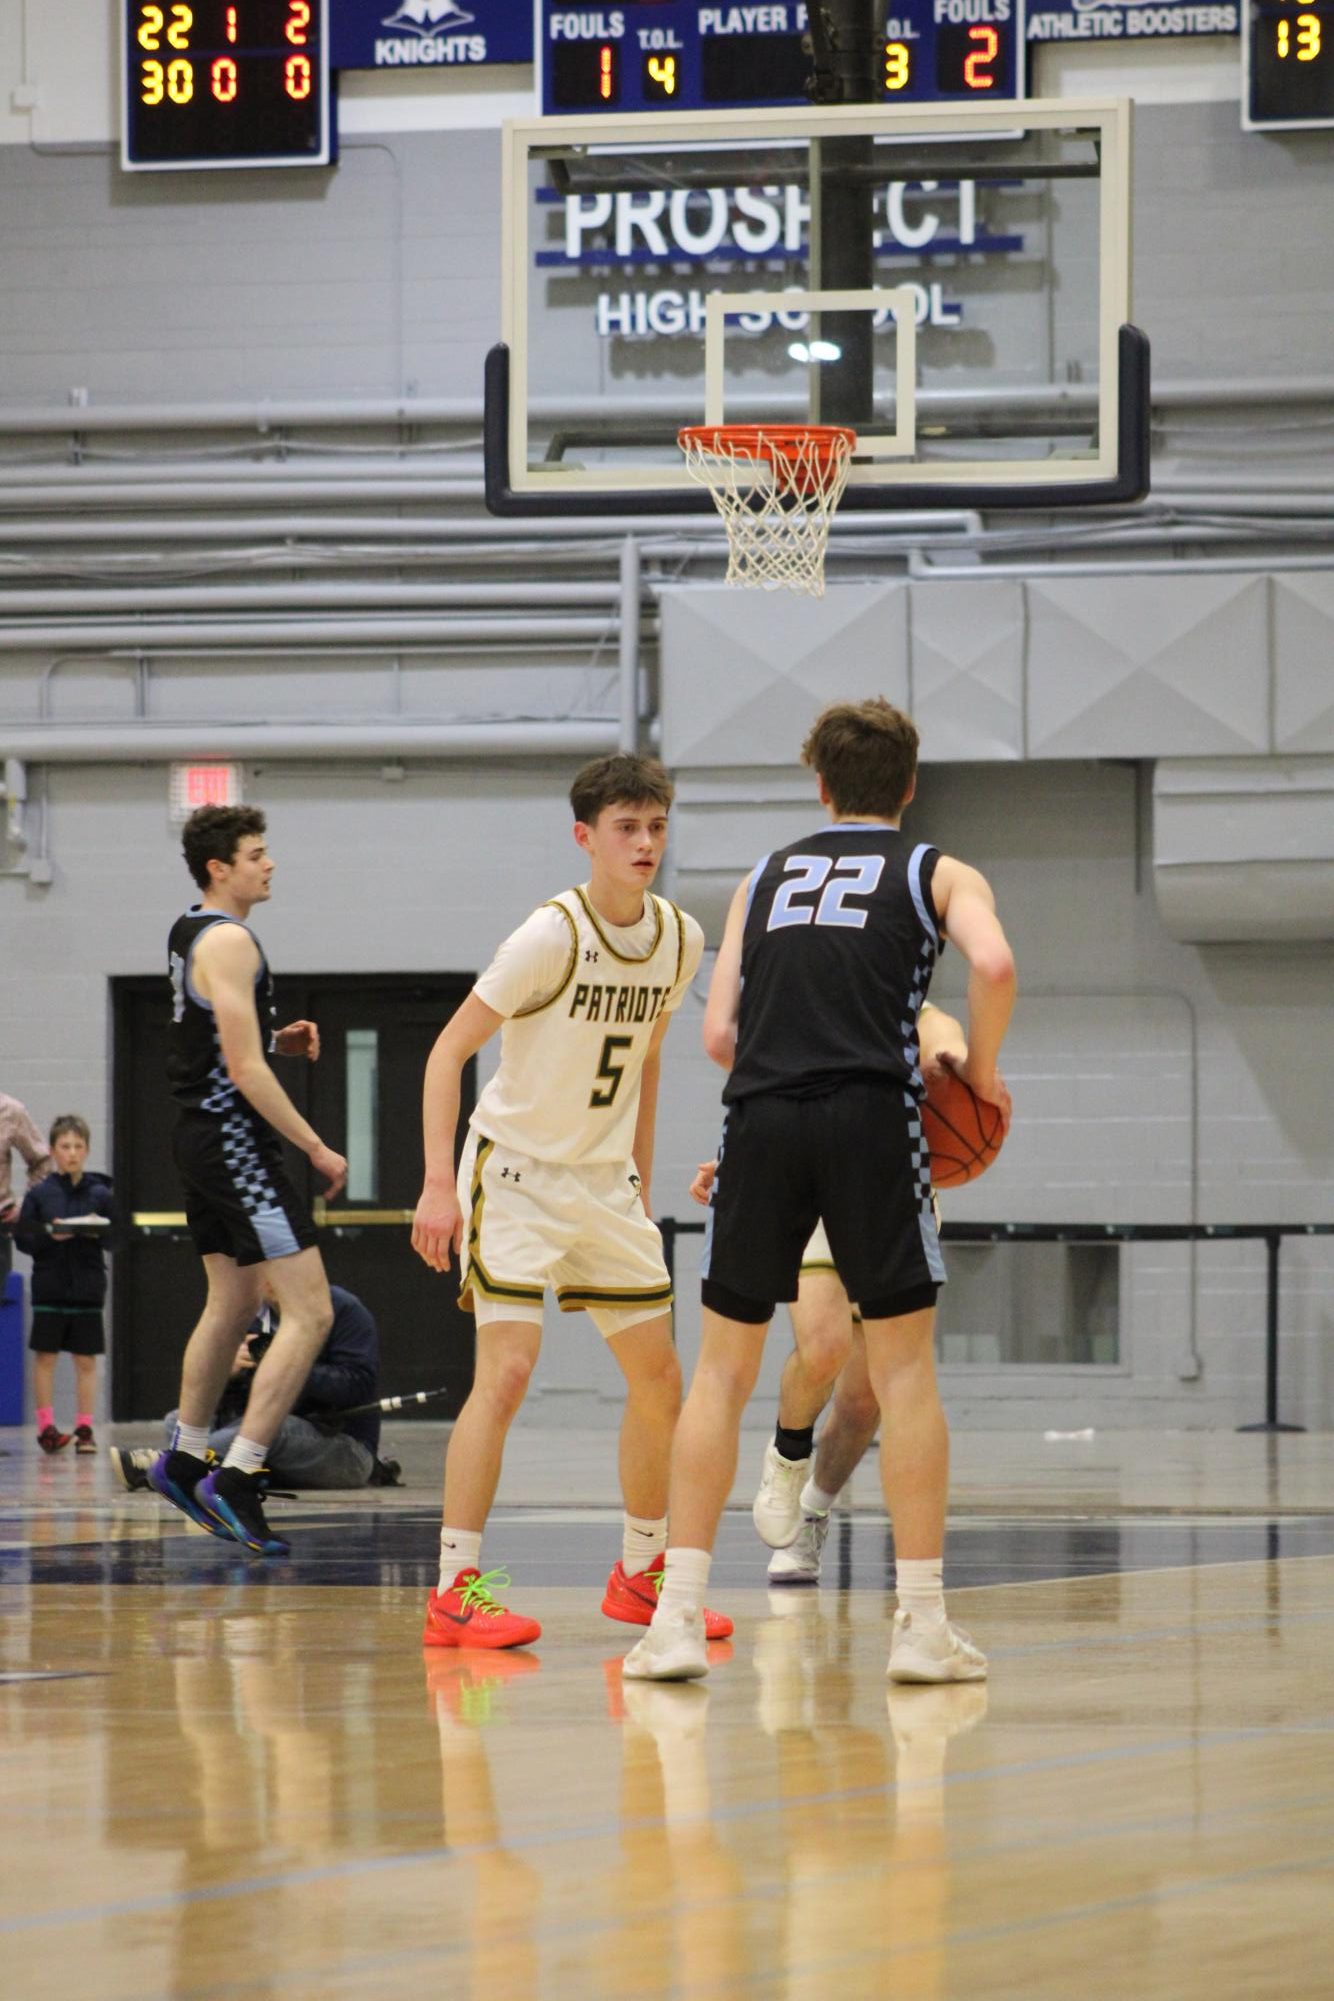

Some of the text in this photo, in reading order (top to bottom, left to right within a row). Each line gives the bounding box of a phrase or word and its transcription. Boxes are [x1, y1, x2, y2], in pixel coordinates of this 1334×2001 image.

[138, 0, 311, 50] 22 1 2
[550, 11, 625, 39] FOULS
[698, 5, 788, 35] PLAYER
[932, 0, 1011, 23] FOULS
[1027, 5, 1237, 39] ATHLETIC BOOSTERS
[375, 36, 486, 65] KNIGHTS
[964, 26, 998, 88] 2
[1277, 13, 1321, 61] 13
[141, 54, 310, 105] 30 0 0
[600, 46, 612, 98] 1
[648, 56, 675, 94] 4
[885, 43, 909, 89] 3
[566, 180, 975, 258] PROSCT
[766, 855, 886, 932] 22
[588, 1035, 634, 1109] 5
